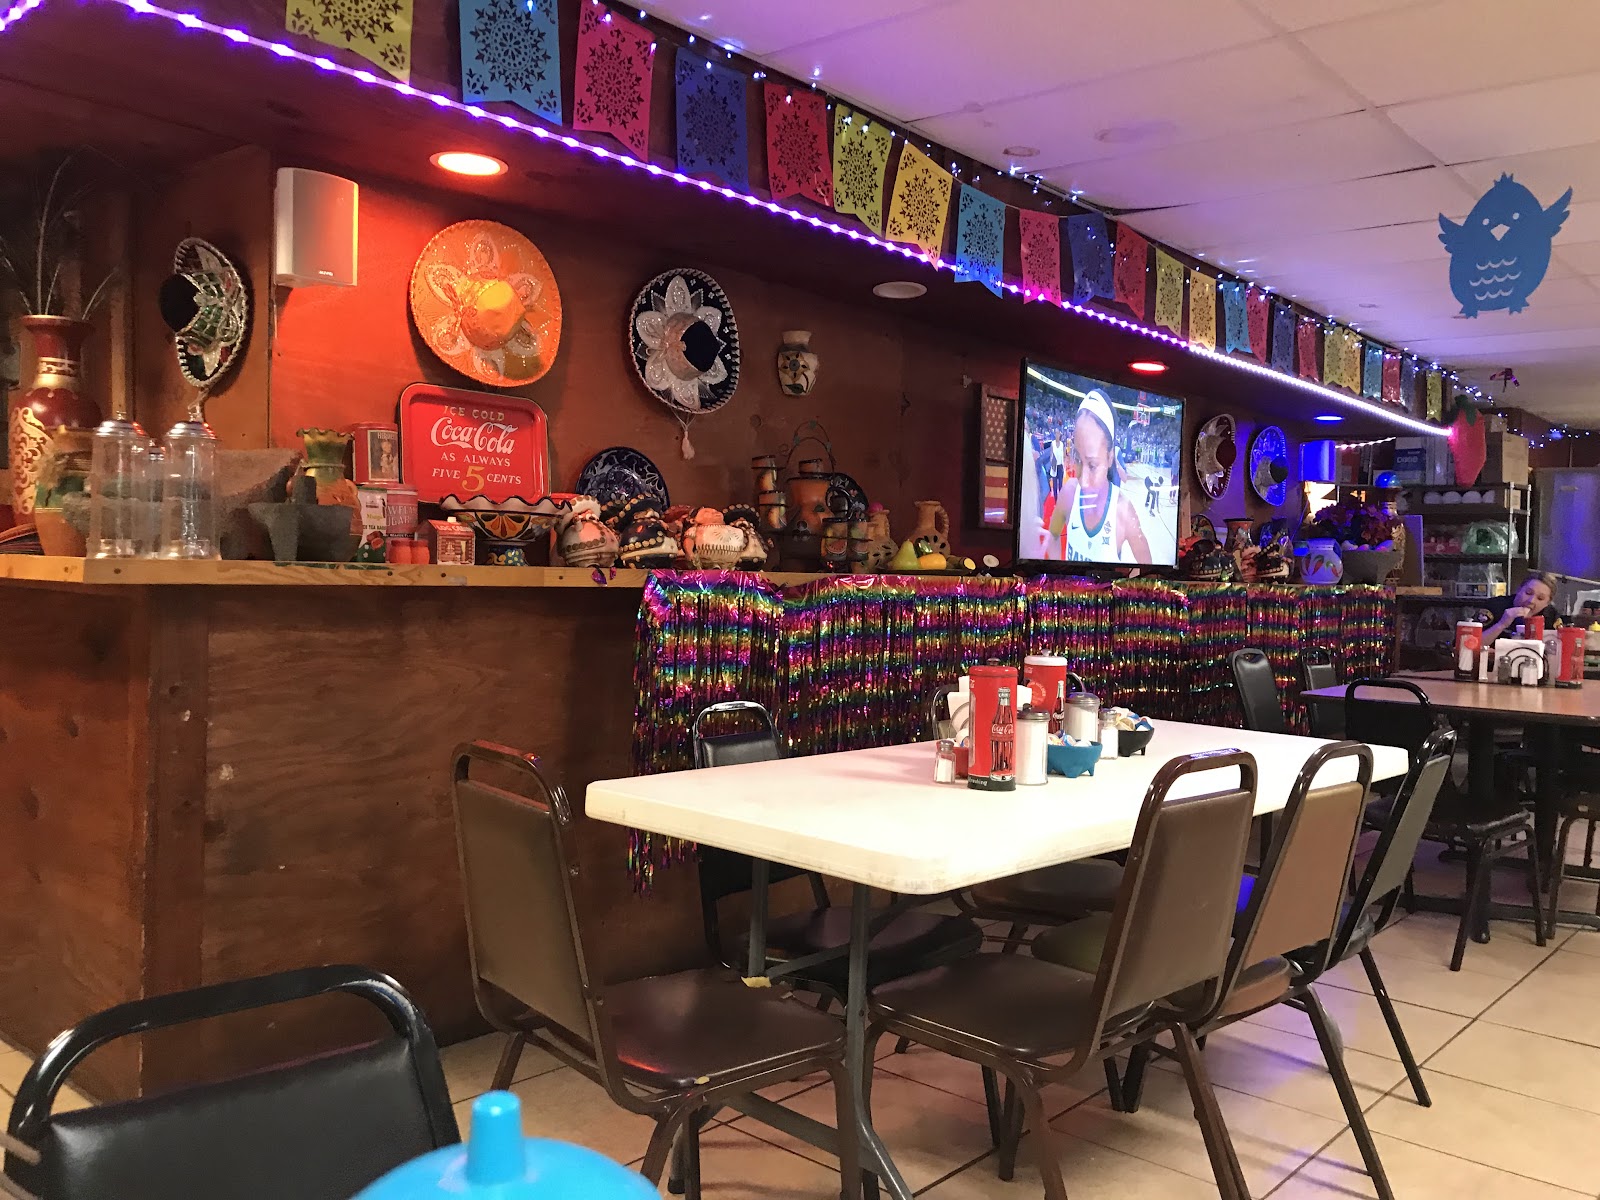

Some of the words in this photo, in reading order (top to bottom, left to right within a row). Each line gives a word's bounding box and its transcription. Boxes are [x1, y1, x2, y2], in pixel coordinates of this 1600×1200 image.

[443, 405, 465, 416] ICE
[472, 409, 505, 421] COLD
[431, 417, 518, 454] Coca-Cola
[440, 452, 456, 462] AS
[463, 454, 510, 467] ALWAYS
[432, 468, 461, 479] FIVE
[461, 465, 485, 492] 5
[486, 473, 522, 485] CENTS
